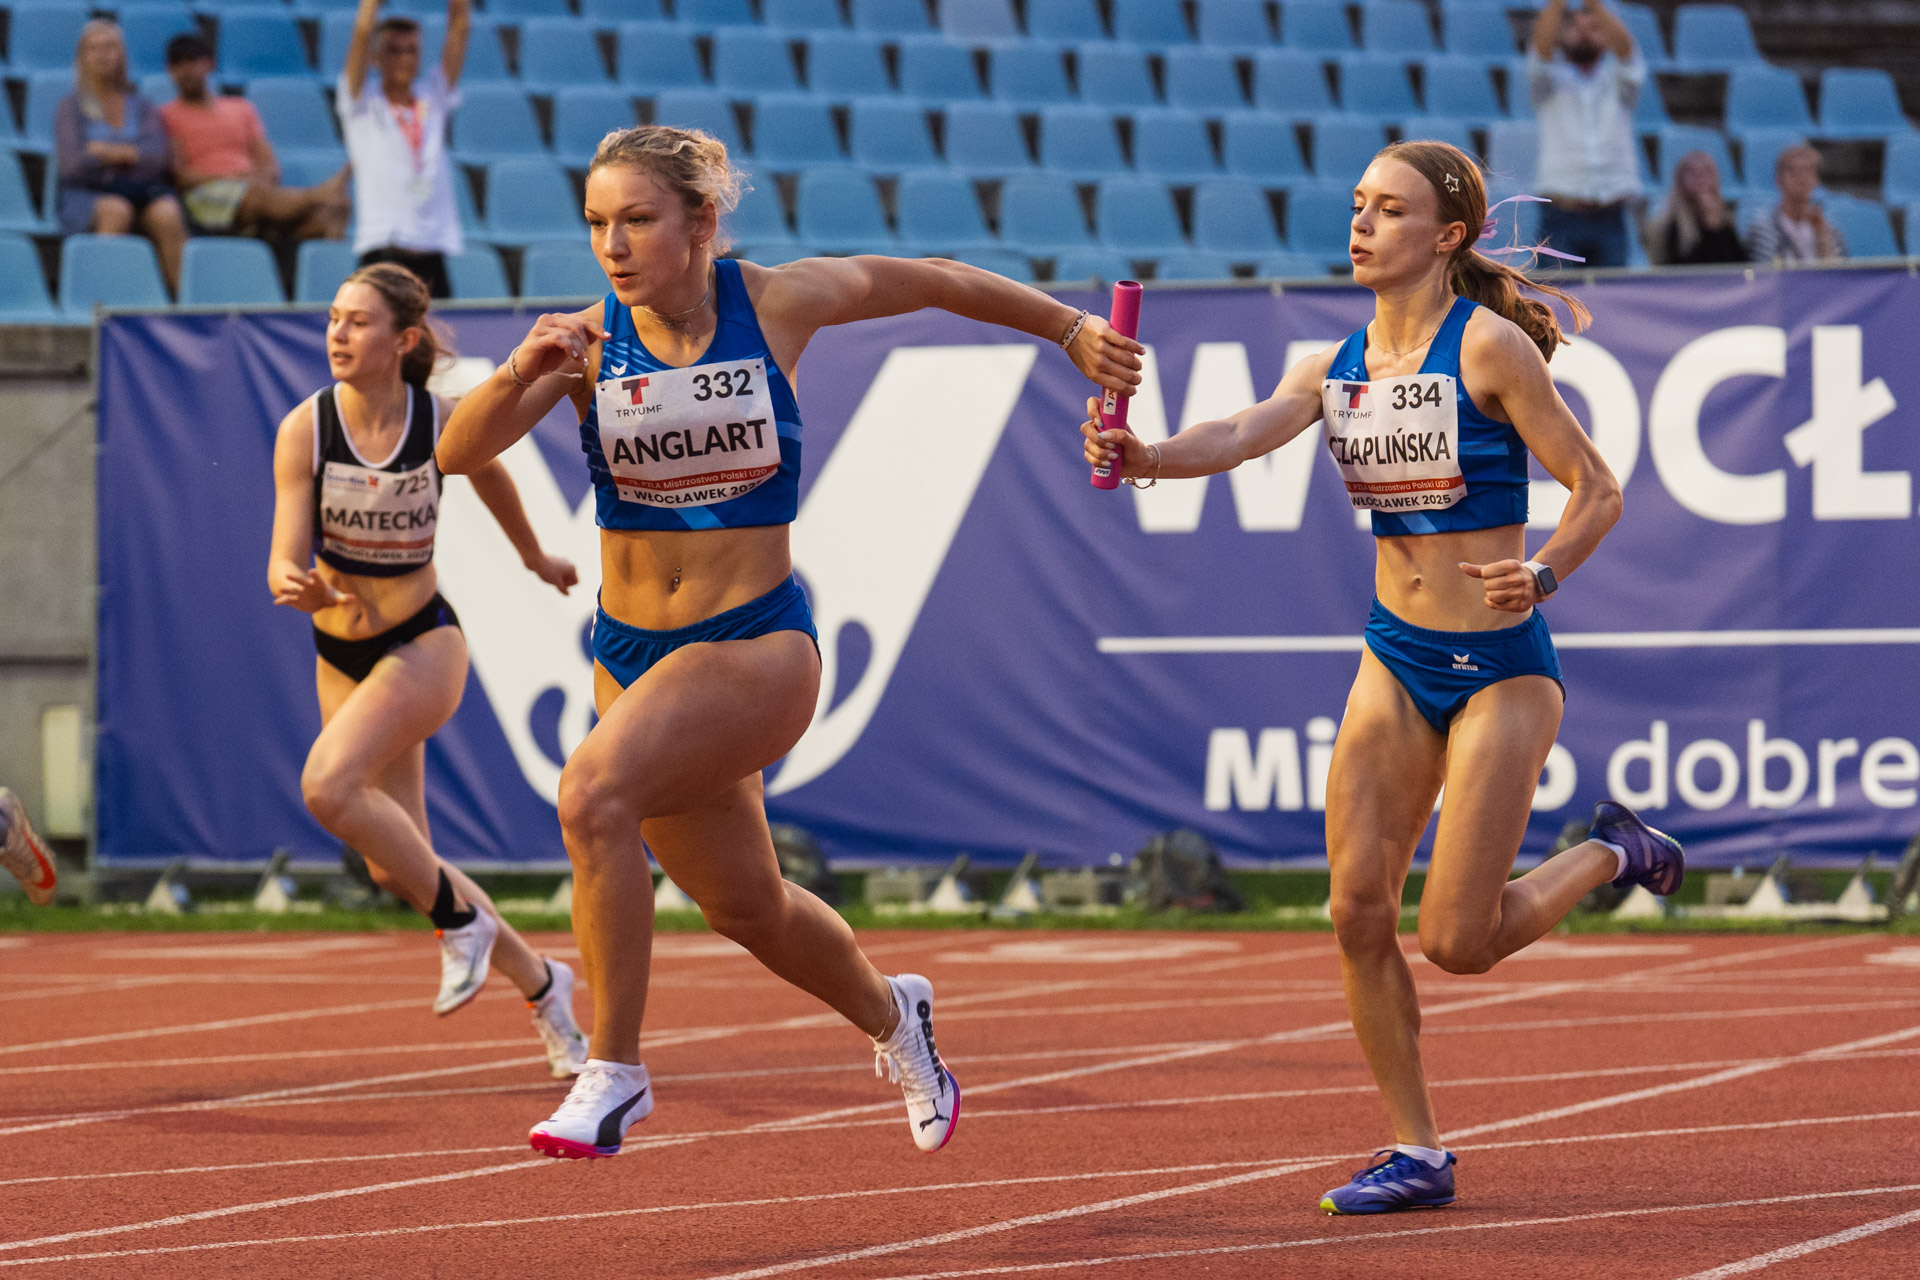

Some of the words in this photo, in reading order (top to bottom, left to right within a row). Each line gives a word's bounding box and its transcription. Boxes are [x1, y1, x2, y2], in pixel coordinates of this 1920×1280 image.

[692, 368, 753, 401] 332
[1392, 382, 1442, 411] 334
[616, 404, 663, 418] TRYUMF
[1333, 410, 1372, 419] TRYUMF
[612, 418, 767, 465] ANGLART
[1126, 324, 1920, 534] WOCŁ
[1329, 427, 1451, 466] CZAPLIŃSKA
[393, 469, 429, 496] 725
[663, 474, 718, 490] Mistrzostwa
[720, 470, 747, 481] Polski
[749, 468, 767, 478] U20
[1412, 481, 1434, 490] Polski
[1435, 480, 1450, 488] U20
[633, 487, 728, 504] WŁOCŁAWEK
[1351, 495, 1420, 509] WŁOCŁAWEK
[1422, 494, 1451, 505] 2025
[325, 502, 437, 530] MATECKA
[1452, 663, 1479, 671] erima
[1204, 716, 1578, 812] Mio
